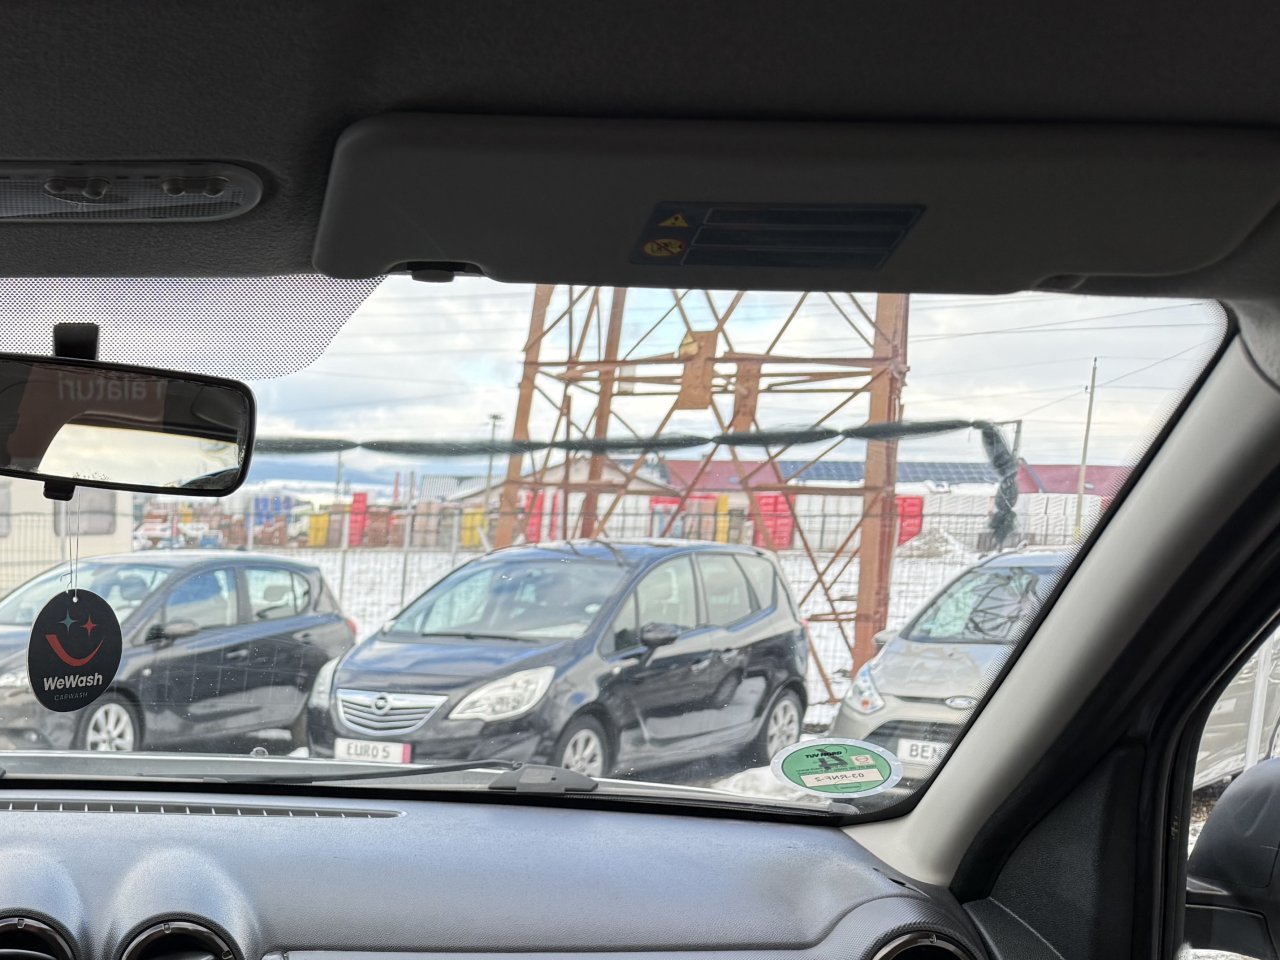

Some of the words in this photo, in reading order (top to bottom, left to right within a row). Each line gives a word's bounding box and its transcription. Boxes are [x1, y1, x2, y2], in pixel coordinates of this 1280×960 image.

[43, 672, 103, 691] WeWash
[54, 692, 88, 701] CARWASH
[346, 742, 379, 758] EURO
[381, 745, 390, 759] 5
